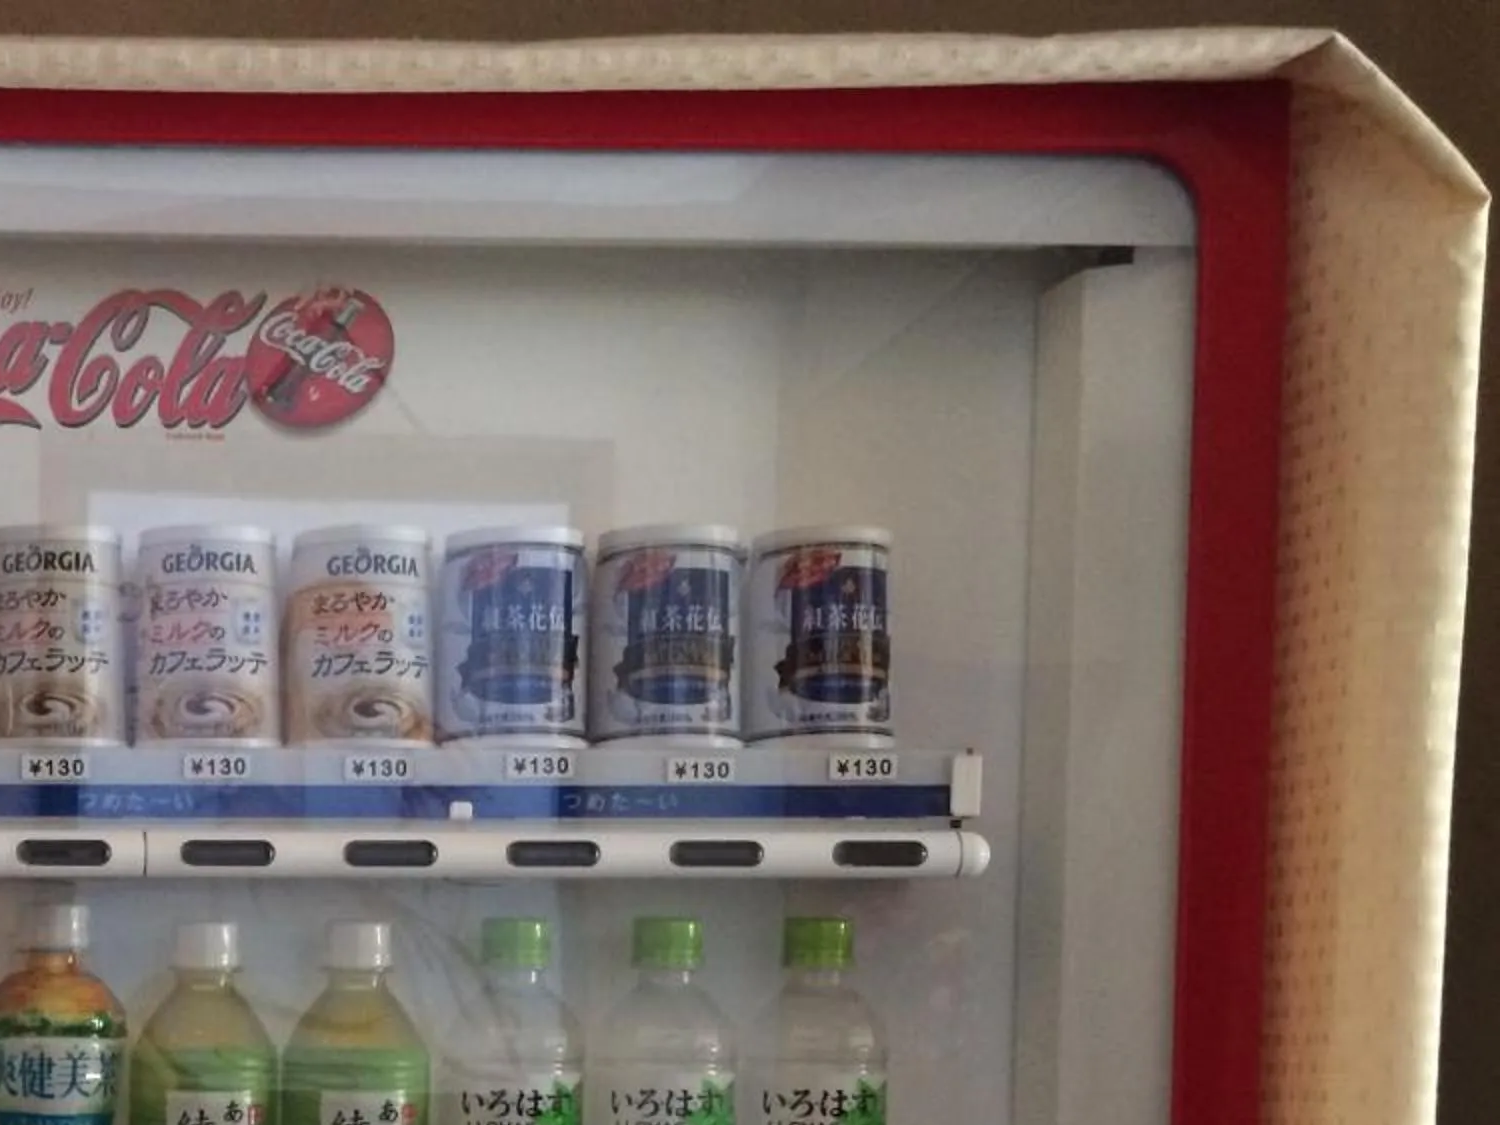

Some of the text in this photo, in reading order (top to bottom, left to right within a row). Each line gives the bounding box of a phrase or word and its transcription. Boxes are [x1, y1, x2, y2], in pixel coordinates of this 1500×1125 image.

[3, 549, 95, 573] GEORGIA
[162, 549, 257, 574] GEORGIA
[327, 551, 419, 576] GEORGIA
[149, 648, 267, 675] カフェラッテ
[312, 650, 429, 678] カフェラッテ
[29, 758, 84, 777] ¥130
[191, 757, 246, 776] ¥130
[352, 759, 408, 778] ¥130
[514, 756, 570, 775] ¥130
[675, 761, 730, 780] ¥130
[837, 758, 892, 777] ¥130
